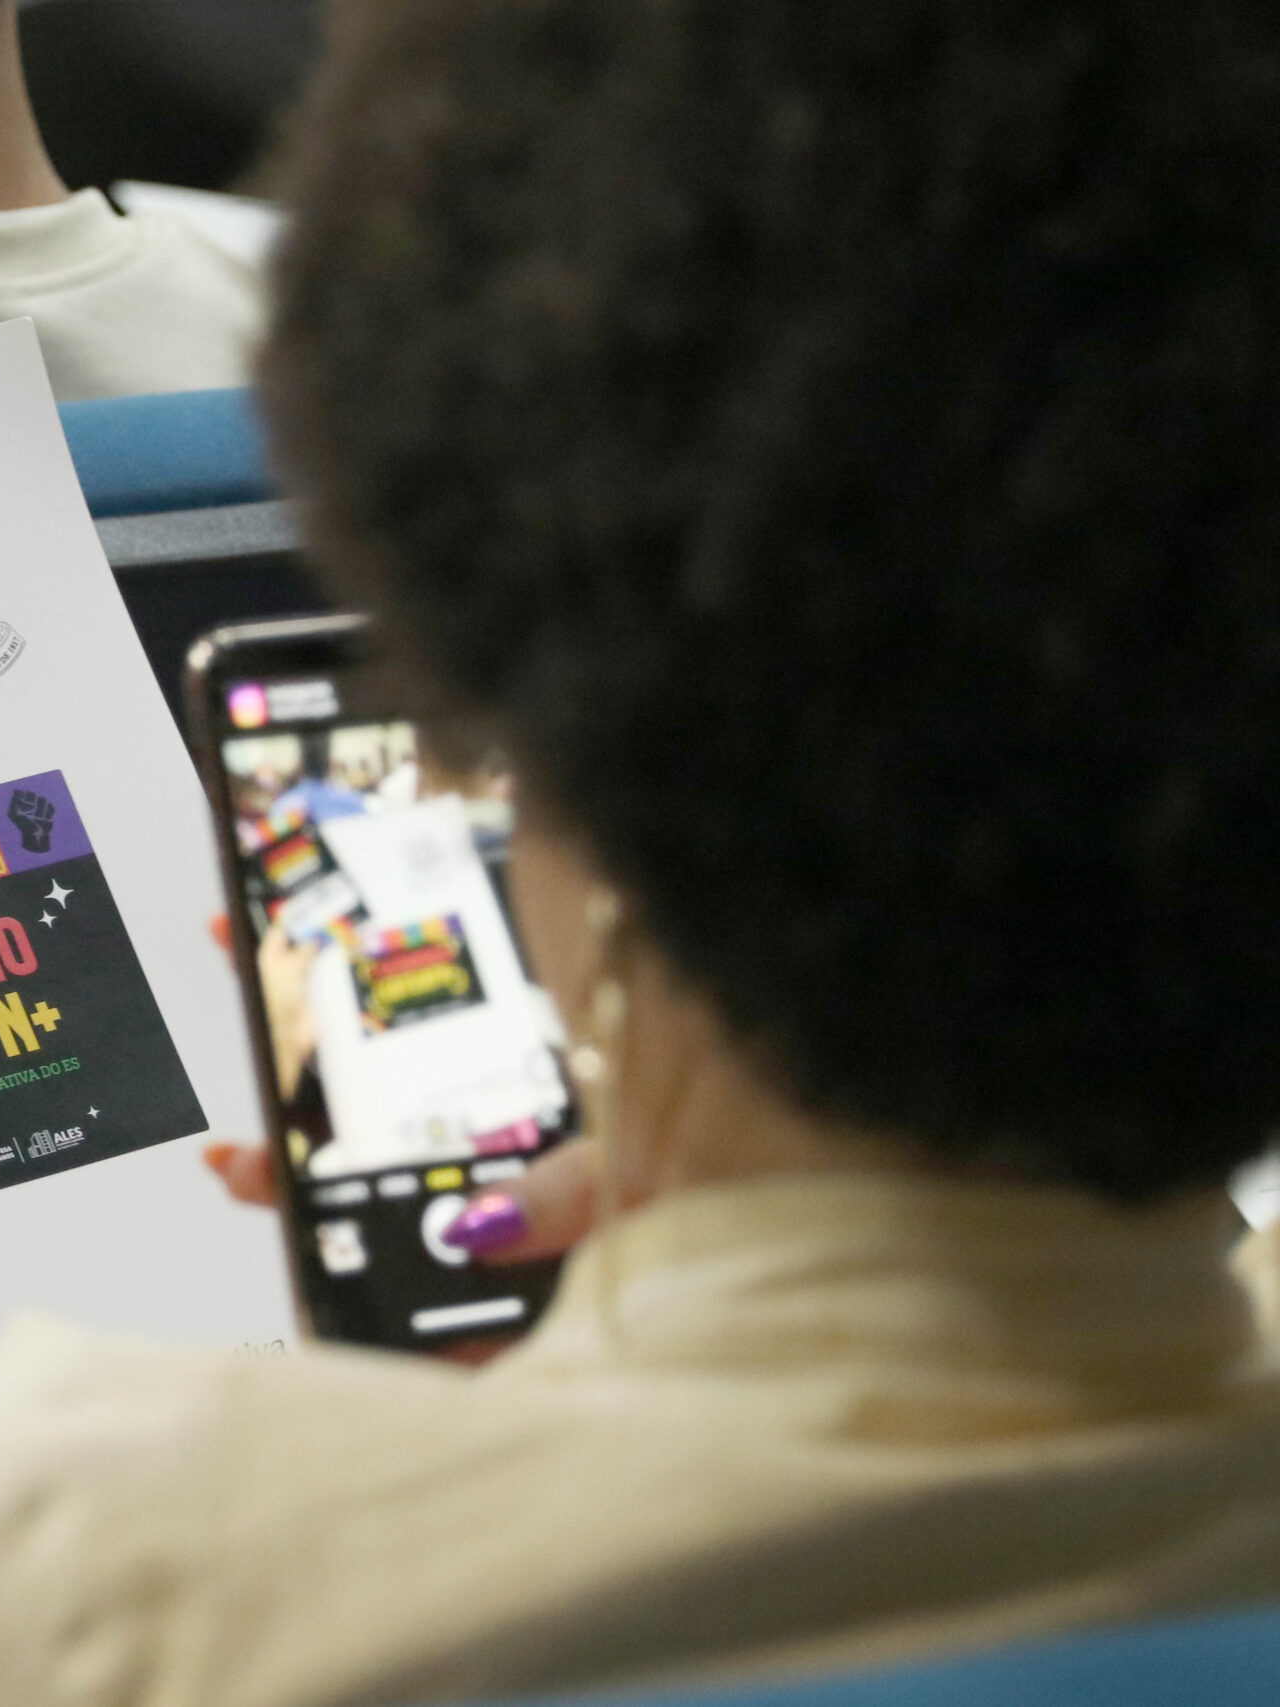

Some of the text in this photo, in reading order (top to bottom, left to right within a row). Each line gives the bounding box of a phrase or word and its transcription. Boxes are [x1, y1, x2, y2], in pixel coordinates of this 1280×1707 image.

[40, 1062, 61, 1078] DO
[61, 1057, 81, 1072] ES
[54, 1126, 84, 1143] ALES
